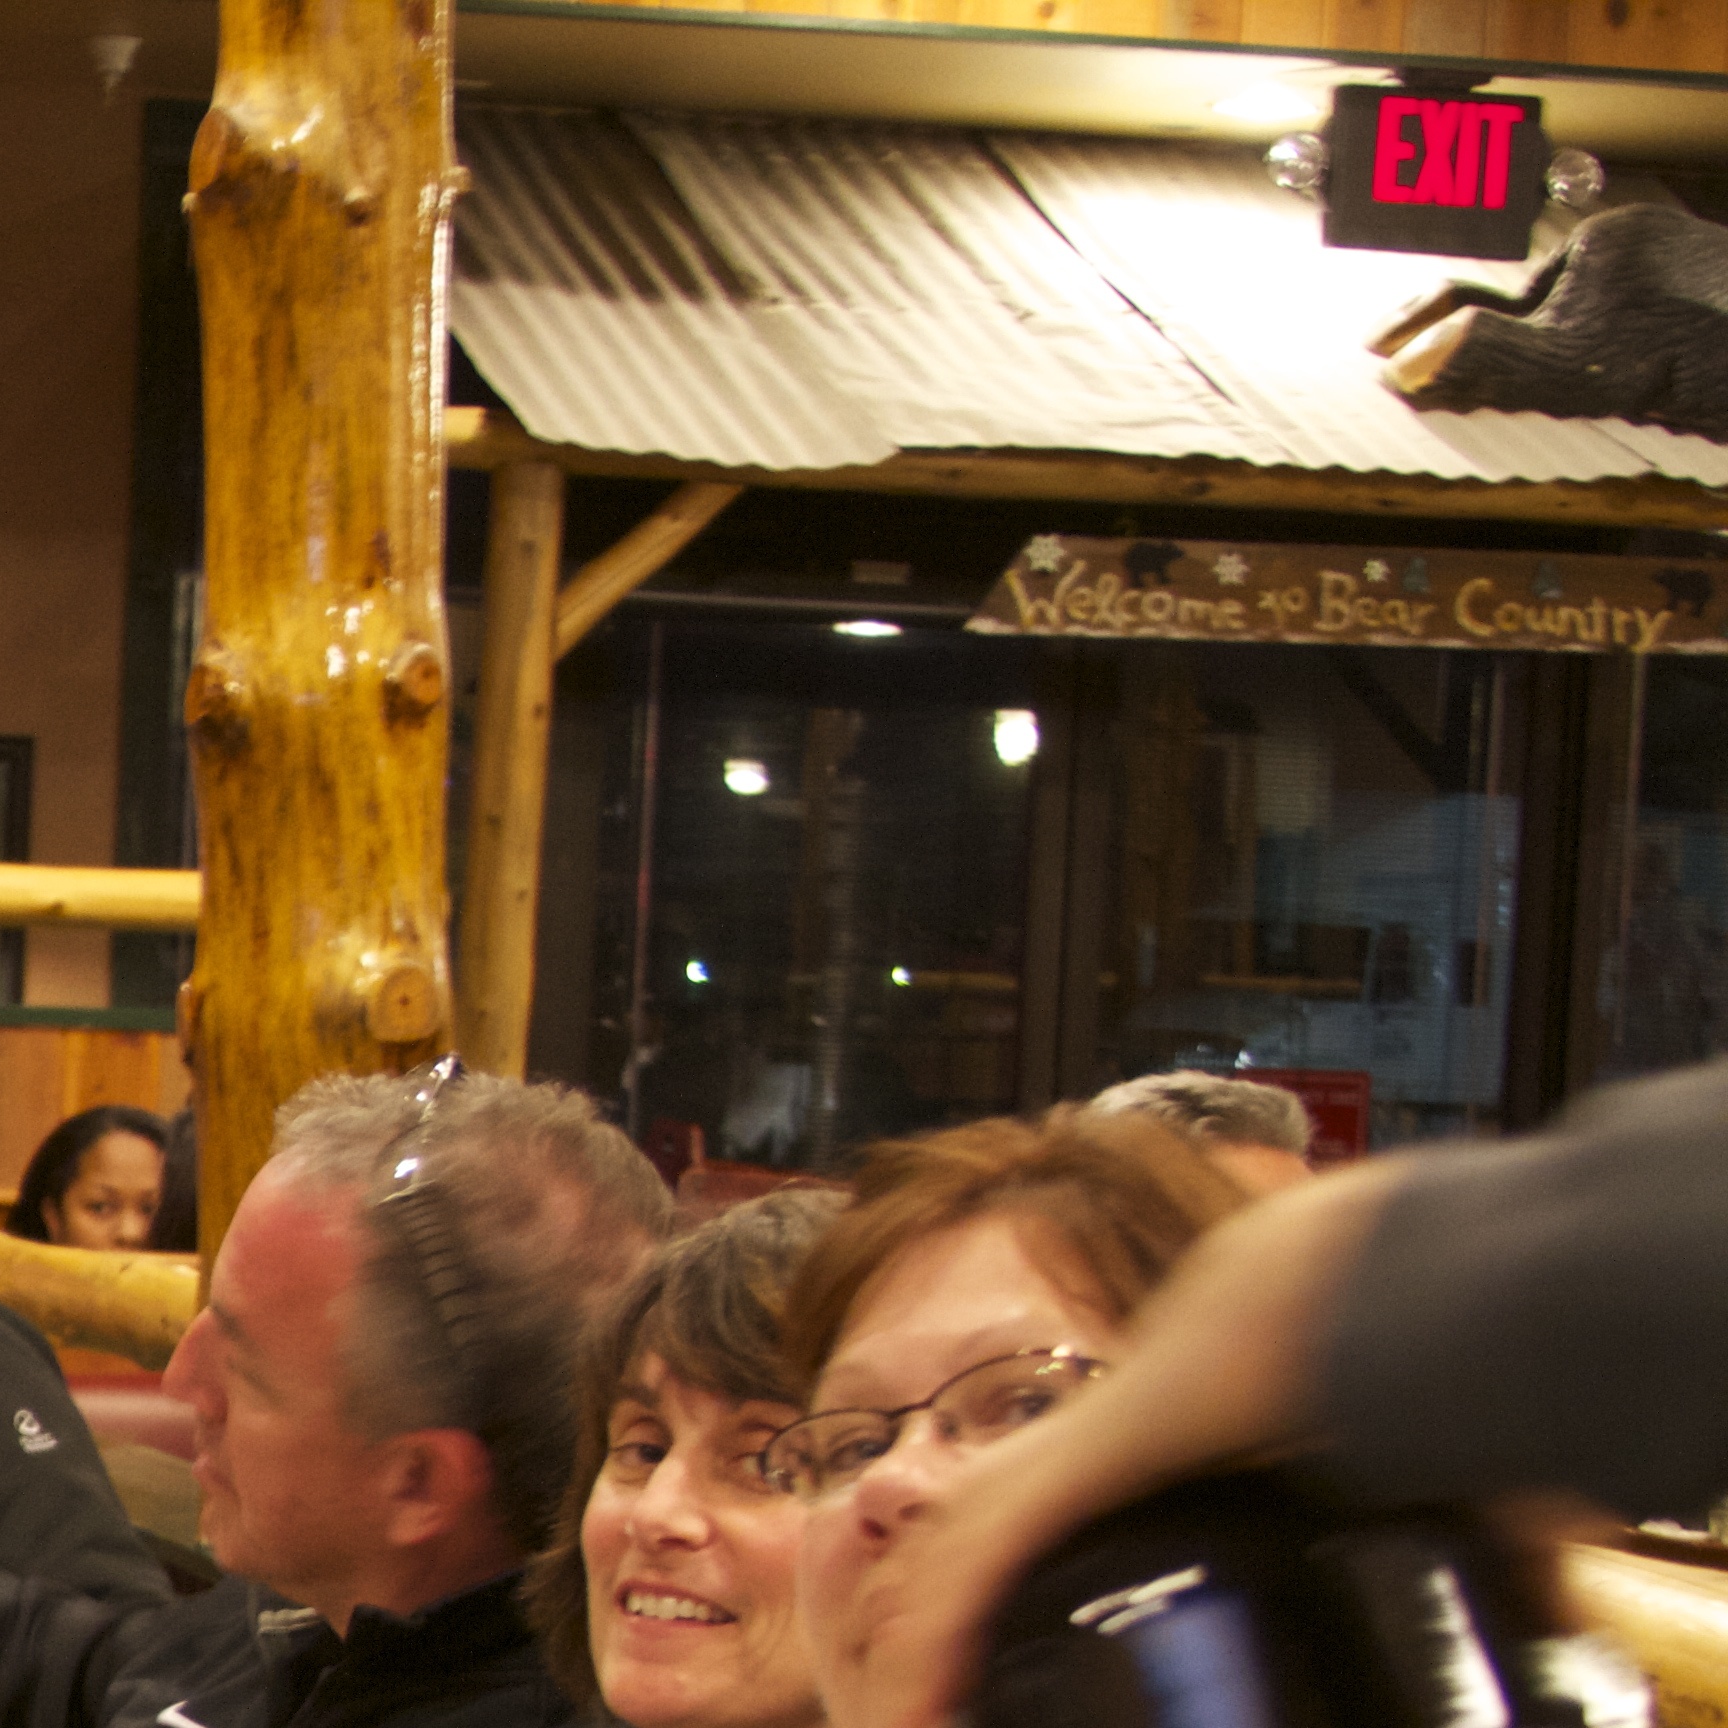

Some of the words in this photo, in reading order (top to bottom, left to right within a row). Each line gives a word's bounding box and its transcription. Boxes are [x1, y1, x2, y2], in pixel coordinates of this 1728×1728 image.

[1372, 97, 1524, 209] EXIT
[1005, 560, 1248, 631] Welcome
[1315, 571, 1435, 635] Bear
[1454, 578, 1673, 653] Country
